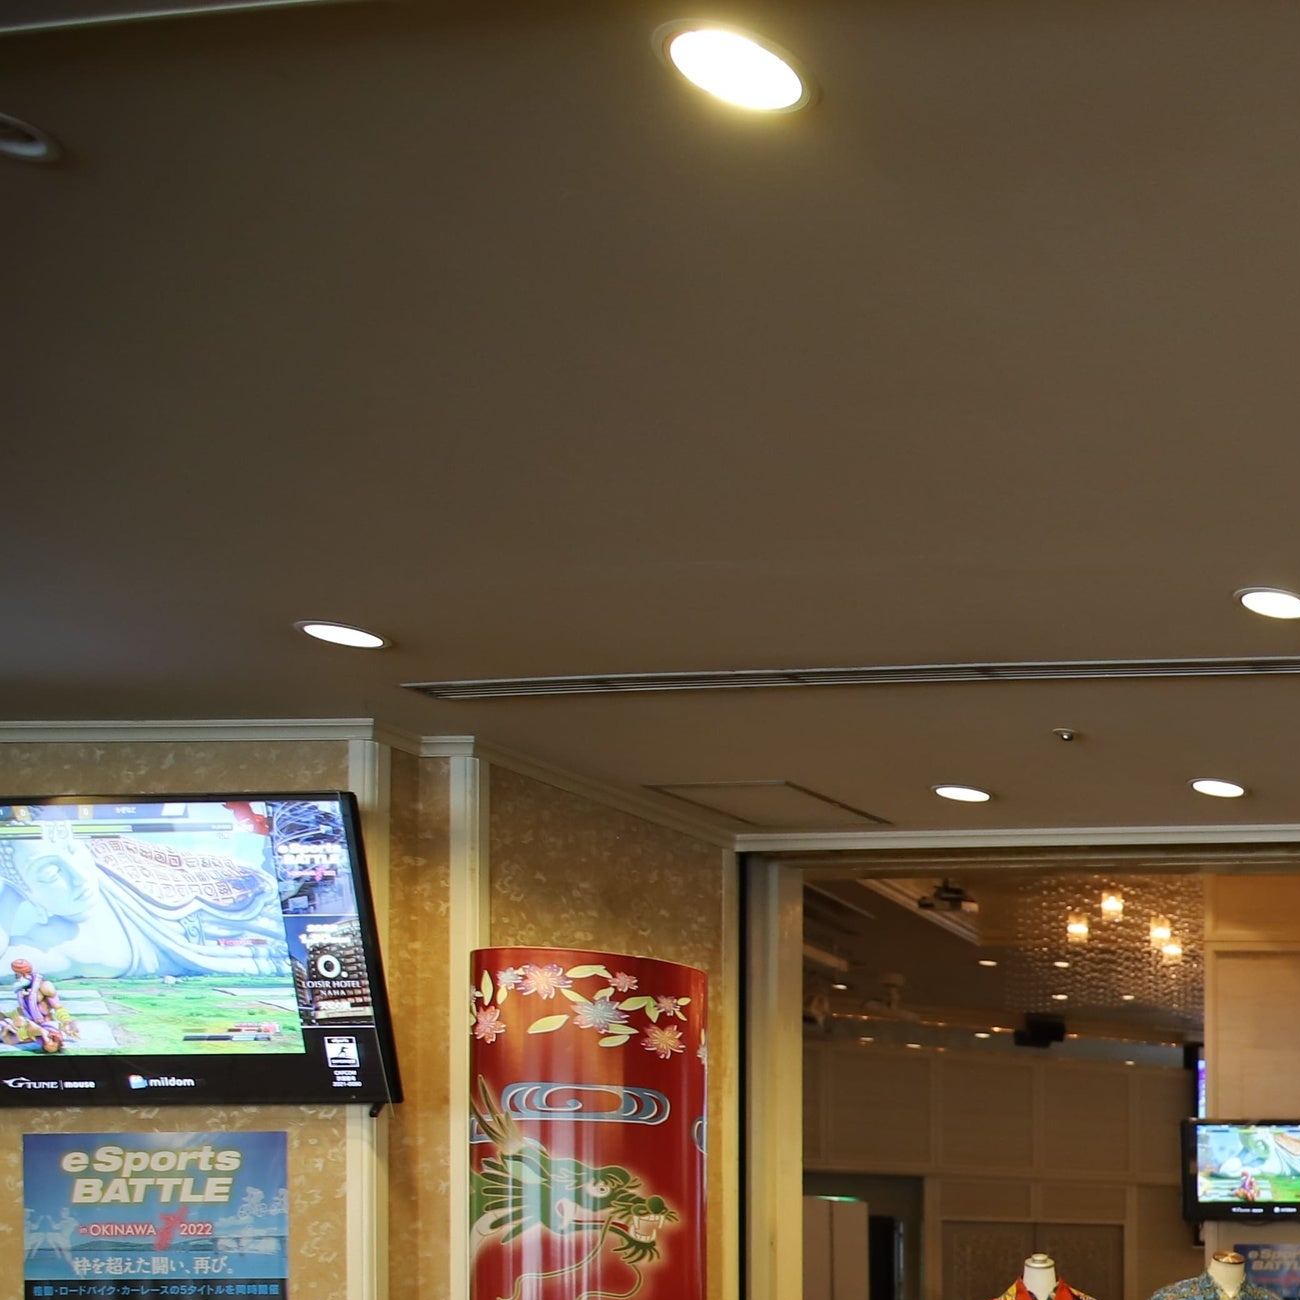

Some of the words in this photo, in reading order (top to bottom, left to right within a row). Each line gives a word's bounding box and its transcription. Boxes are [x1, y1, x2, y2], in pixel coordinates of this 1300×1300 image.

[302, 980, 331, 989] LOISIR
[332, 980, 361, 988] HOTEL
[64, 1080, 96, 1089] mouse
[149, 1077, 196, 1088] mildom
[71, 1177, 234, 1203] BATTLE
[78, 1226, 88, 1234] in
[89, 1224, 157, 1236] OKINAWA
[179, 1223, 213, 1236] 2022
[73, 1256, 234, 1275] 枠を超えた闘い、再び。
